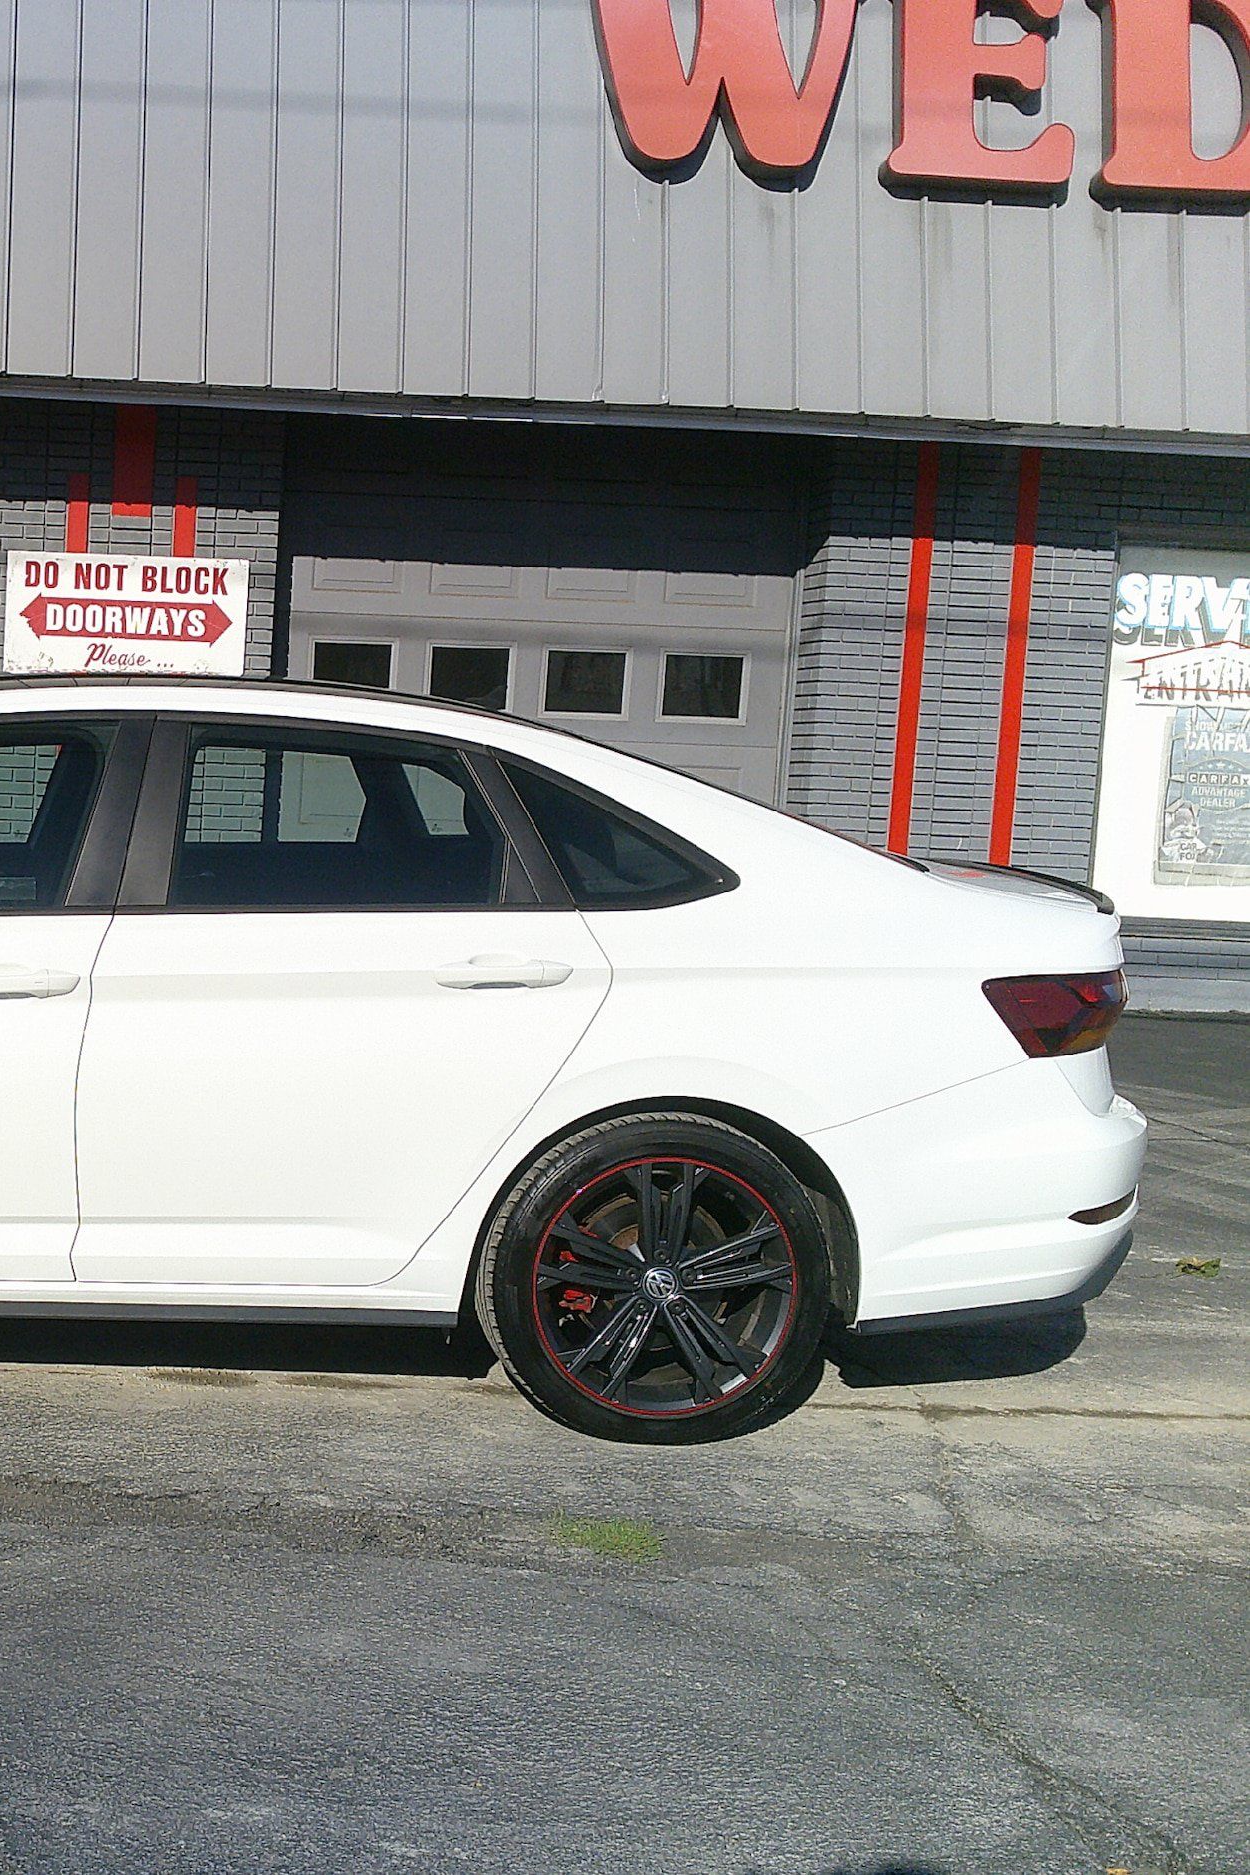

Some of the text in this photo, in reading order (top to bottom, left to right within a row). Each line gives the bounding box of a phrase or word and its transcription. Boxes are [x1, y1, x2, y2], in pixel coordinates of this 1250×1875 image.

[25, 560, 228, 596] DO NOT BLOCK
[45, 603, 206, 637] DOORWAYS
[84, 642, 151, 668] Please
[1184, 731, 1250, 752] CARFA
[1191, 786, 1247, 798] ADVANTAGE
[1200, 797, 1236, 808] DEALER
